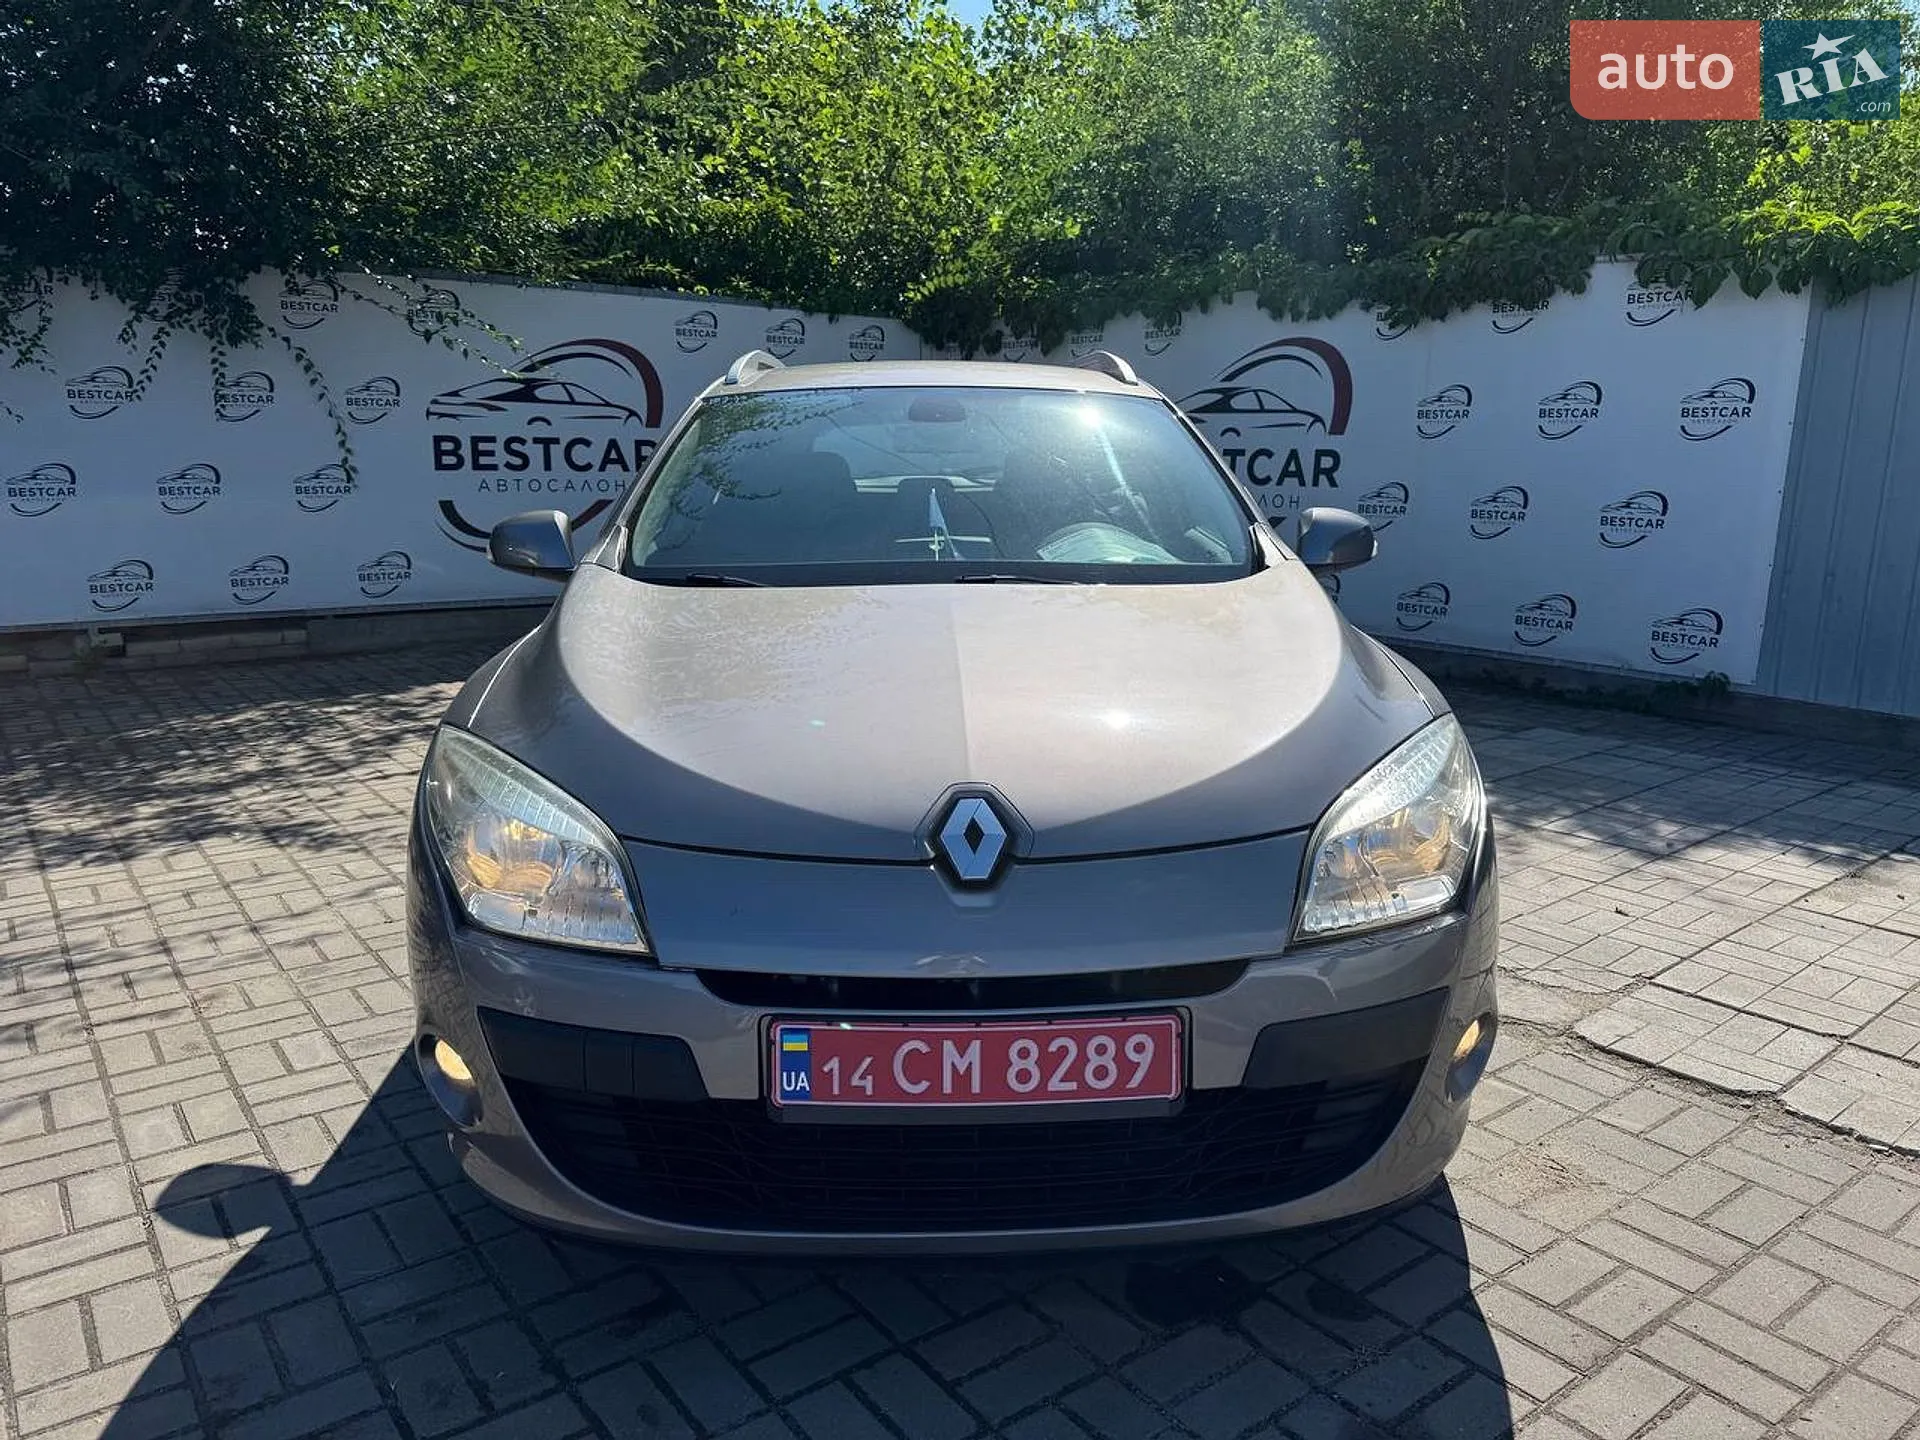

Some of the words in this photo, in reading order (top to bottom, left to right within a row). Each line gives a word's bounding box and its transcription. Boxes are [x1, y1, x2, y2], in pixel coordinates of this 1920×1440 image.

[280, 300, 339, 313] BESTCAR
[675, 328, 718, 338] BESTCAR
[766, 334, 805, 345] BESTCAR
[67, 389, 133, 401] BESTCAR
[346, 397, 401, 409] BESTCAR
[1417, 409, 1470, 420] BESTCAR
[1538, 408, 1599, 419] BESTCAR
[1681, 406, 1752, 419] BESTCAR
[433, 434, 657, 473] BESTCAR
[1221, 448, 1341, 488] TCAR
[158, 486, 221, 497] BESTCAR
[295, 485, 352, 495] BESTCAR
[478, 478, 626, 493] АВТОСАЛОН
[8, 487, 77, 498] BESTCAR
[1358, 503, 1407, 515] BESTCAR
[1471, 509, 1526, 522] BESTCAR
[1600, 515, 1665, 529] BESTCAR
[231, 576, 289, 588] BESTCAR
[358, 571, 412, 583] BESTCAR
[89, 583, 155, 594] BESTCAR
[1397, 602, 1448, 617] BESTCAR
[1515, 615, 1573, 632] BESTCAR
[1651, 630, 1719, 649] BESTCAR
[821, 1056, 875, 1096] 14
[892, 1039, 982, 1095] CM
[1006, 1033, 1155, 1093] 8289
[782, 1072, 810, 1092] UA
